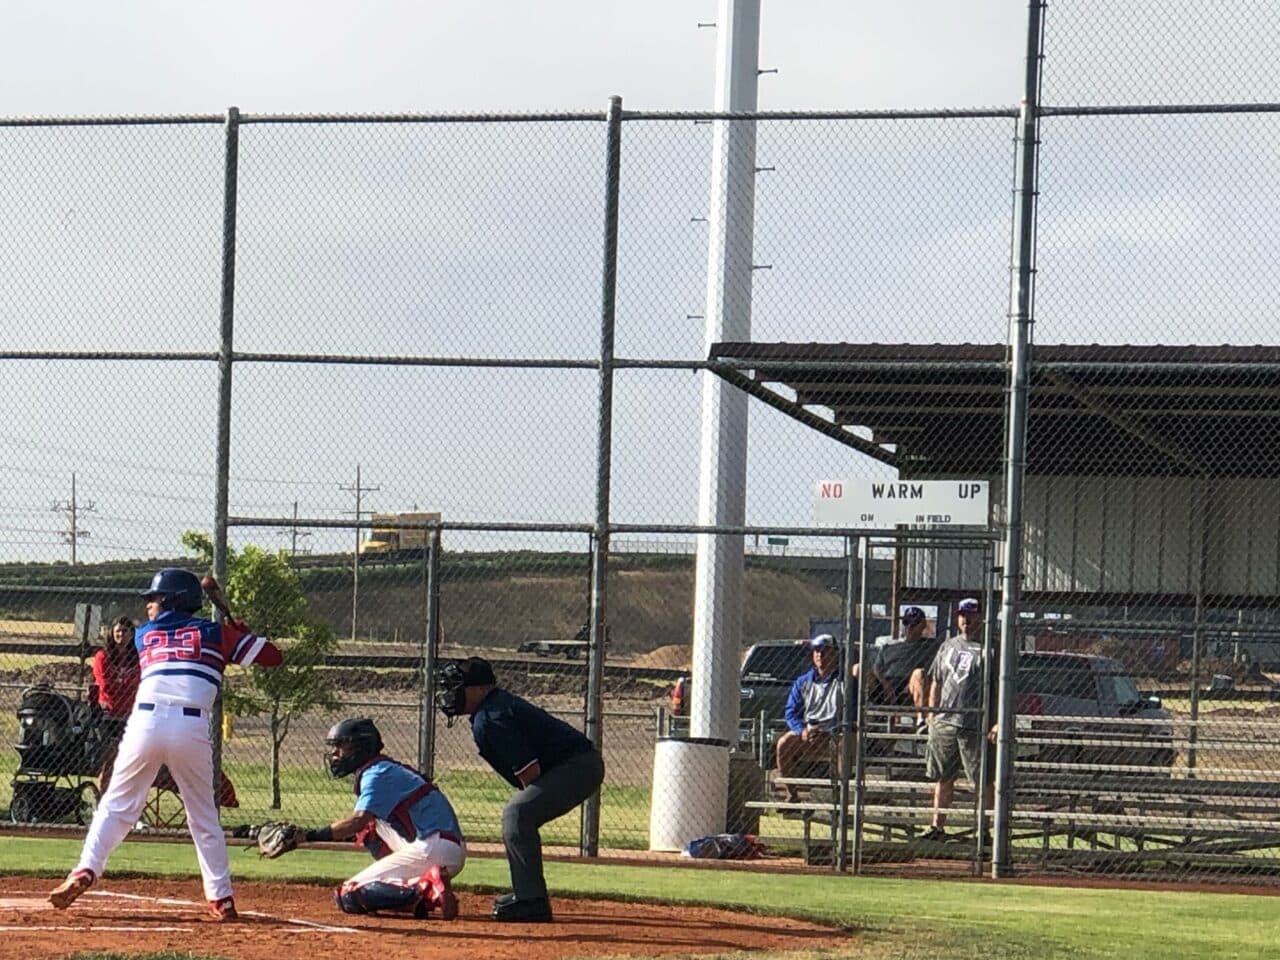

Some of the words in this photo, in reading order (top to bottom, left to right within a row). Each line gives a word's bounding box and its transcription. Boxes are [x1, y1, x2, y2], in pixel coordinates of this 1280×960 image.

[821, 483, 843, 498] NO
[872, 483, 923, 499] WARM
[958, 483, 981, 499] UP
[860, 513, 874, 521] ON
[915, 514, 925, 523] IN
[927, 514, 952, 523] FIELD
[143, 626, 202, 664] 23
